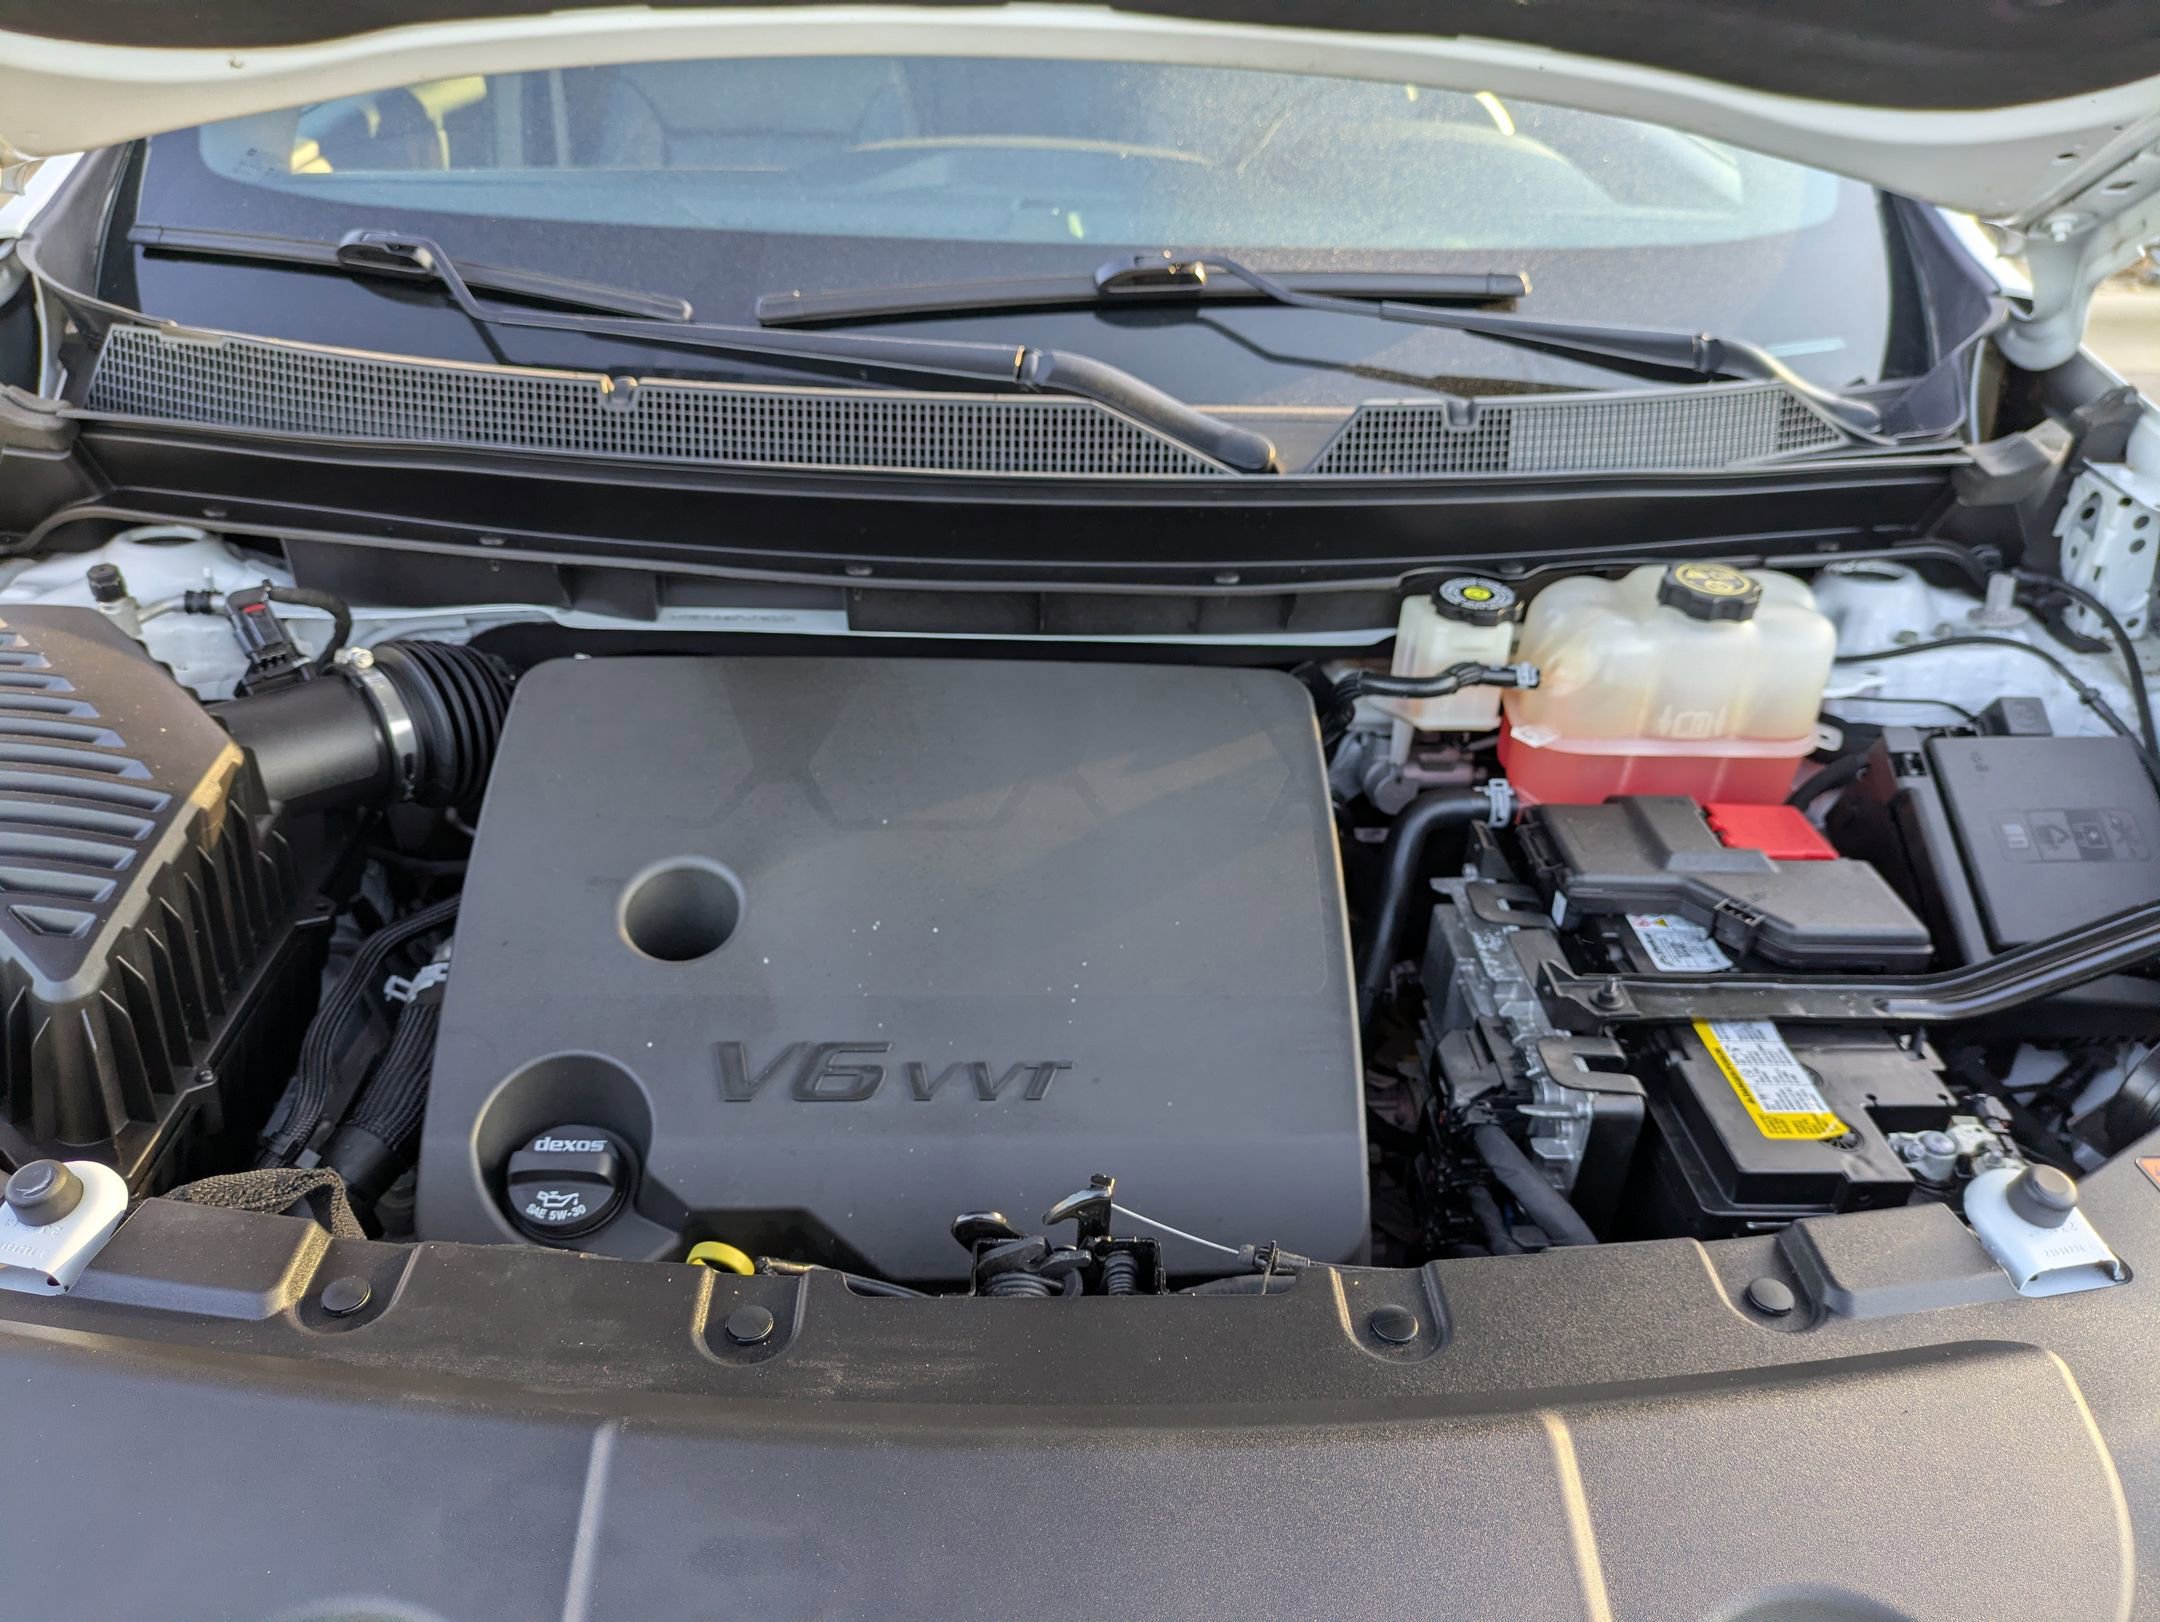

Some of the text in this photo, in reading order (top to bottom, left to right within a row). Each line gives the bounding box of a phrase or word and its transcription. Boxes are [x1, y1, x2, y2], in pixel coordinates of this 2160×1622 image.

[713, 1041, 1073, 1102] V6 VVT
[534, 1136, 608, 1152] dexos
[526, 1203, 587, 1220] SAE 5W-30
